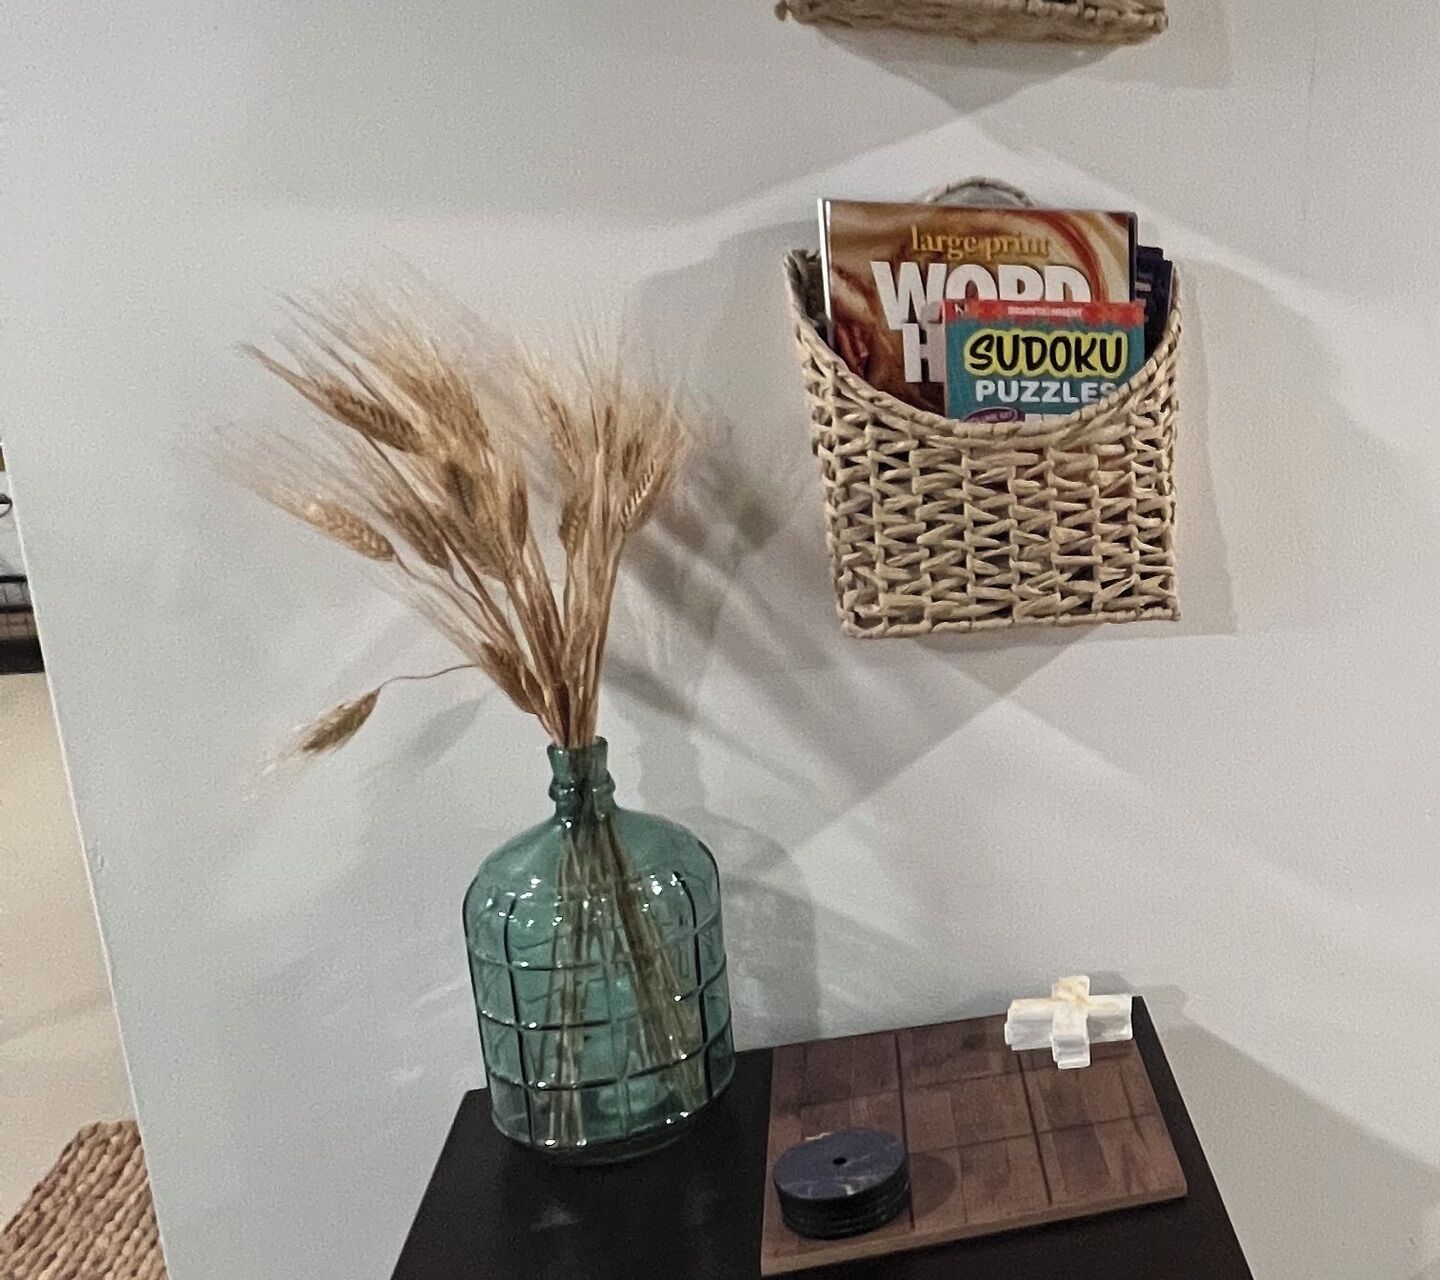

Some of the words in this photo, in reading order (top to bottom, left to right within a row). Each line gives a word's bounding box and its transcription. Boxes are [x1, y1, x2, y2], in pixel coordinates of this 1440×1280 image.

[911, 224, 977, 259] large
[978, 232, 1051, 261] print
[968, 334, 1123, 373] SUDOKU
